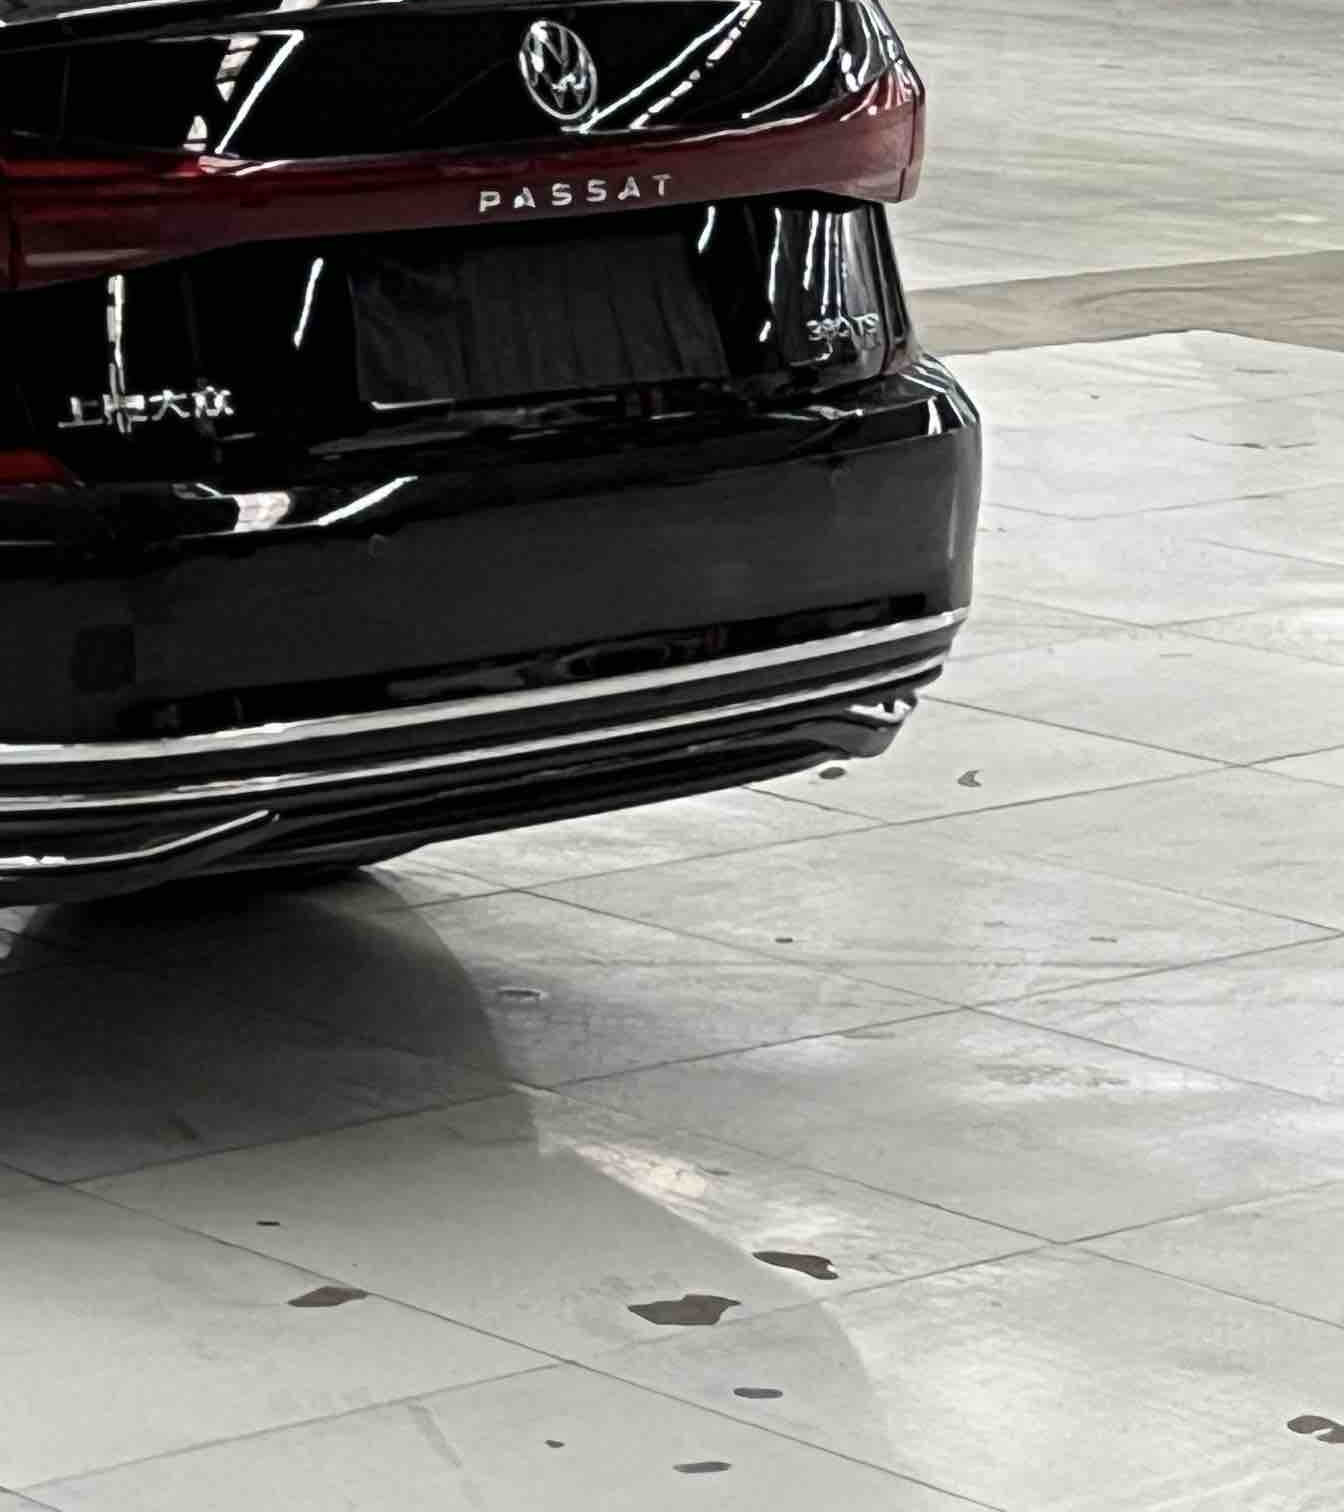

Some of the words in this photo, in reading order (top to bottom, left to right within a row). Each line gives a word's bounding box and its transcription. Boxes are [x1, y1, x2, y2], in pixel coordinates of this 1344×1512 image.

[479, 173, 672, 213] PASSAT
[57, 385, 234, 433] 上汽大众
